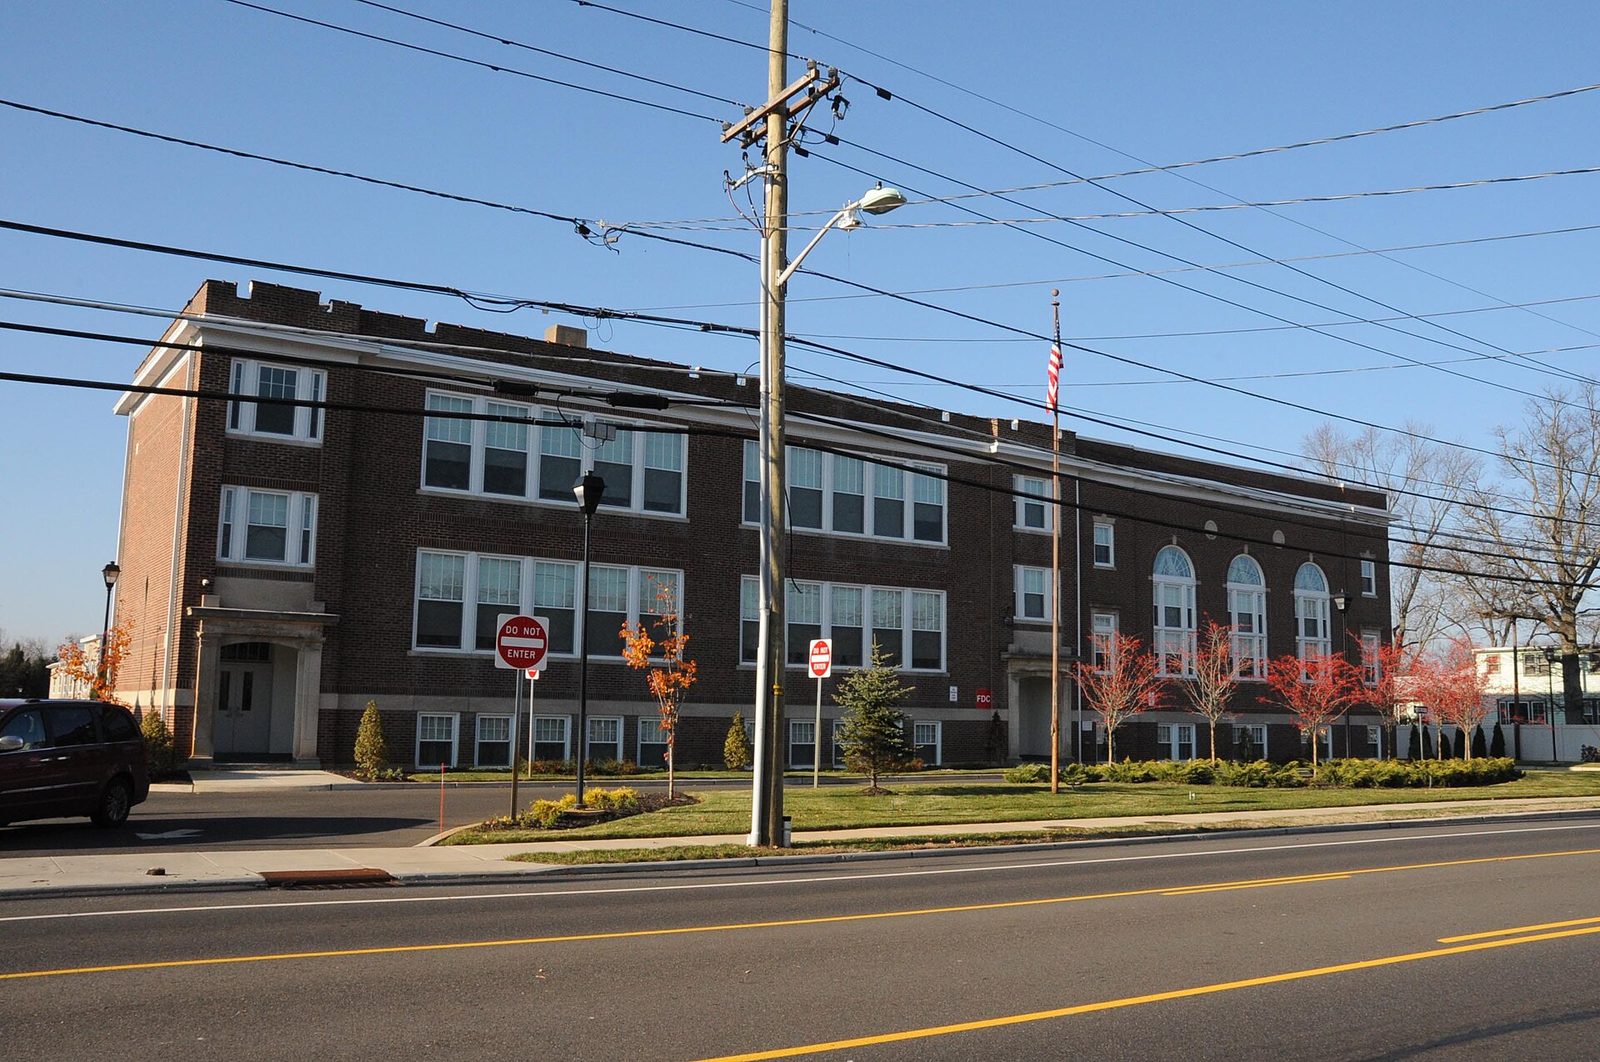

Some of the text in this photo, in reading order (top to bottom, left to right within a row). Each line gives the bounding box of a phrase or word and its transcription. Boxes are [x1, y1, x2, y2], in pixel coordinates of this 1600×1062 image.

[505, 625, 541, 636] DO NOT
[507, 649, 536, 659] ENTER
[976, 694, 991, 703] FDC
